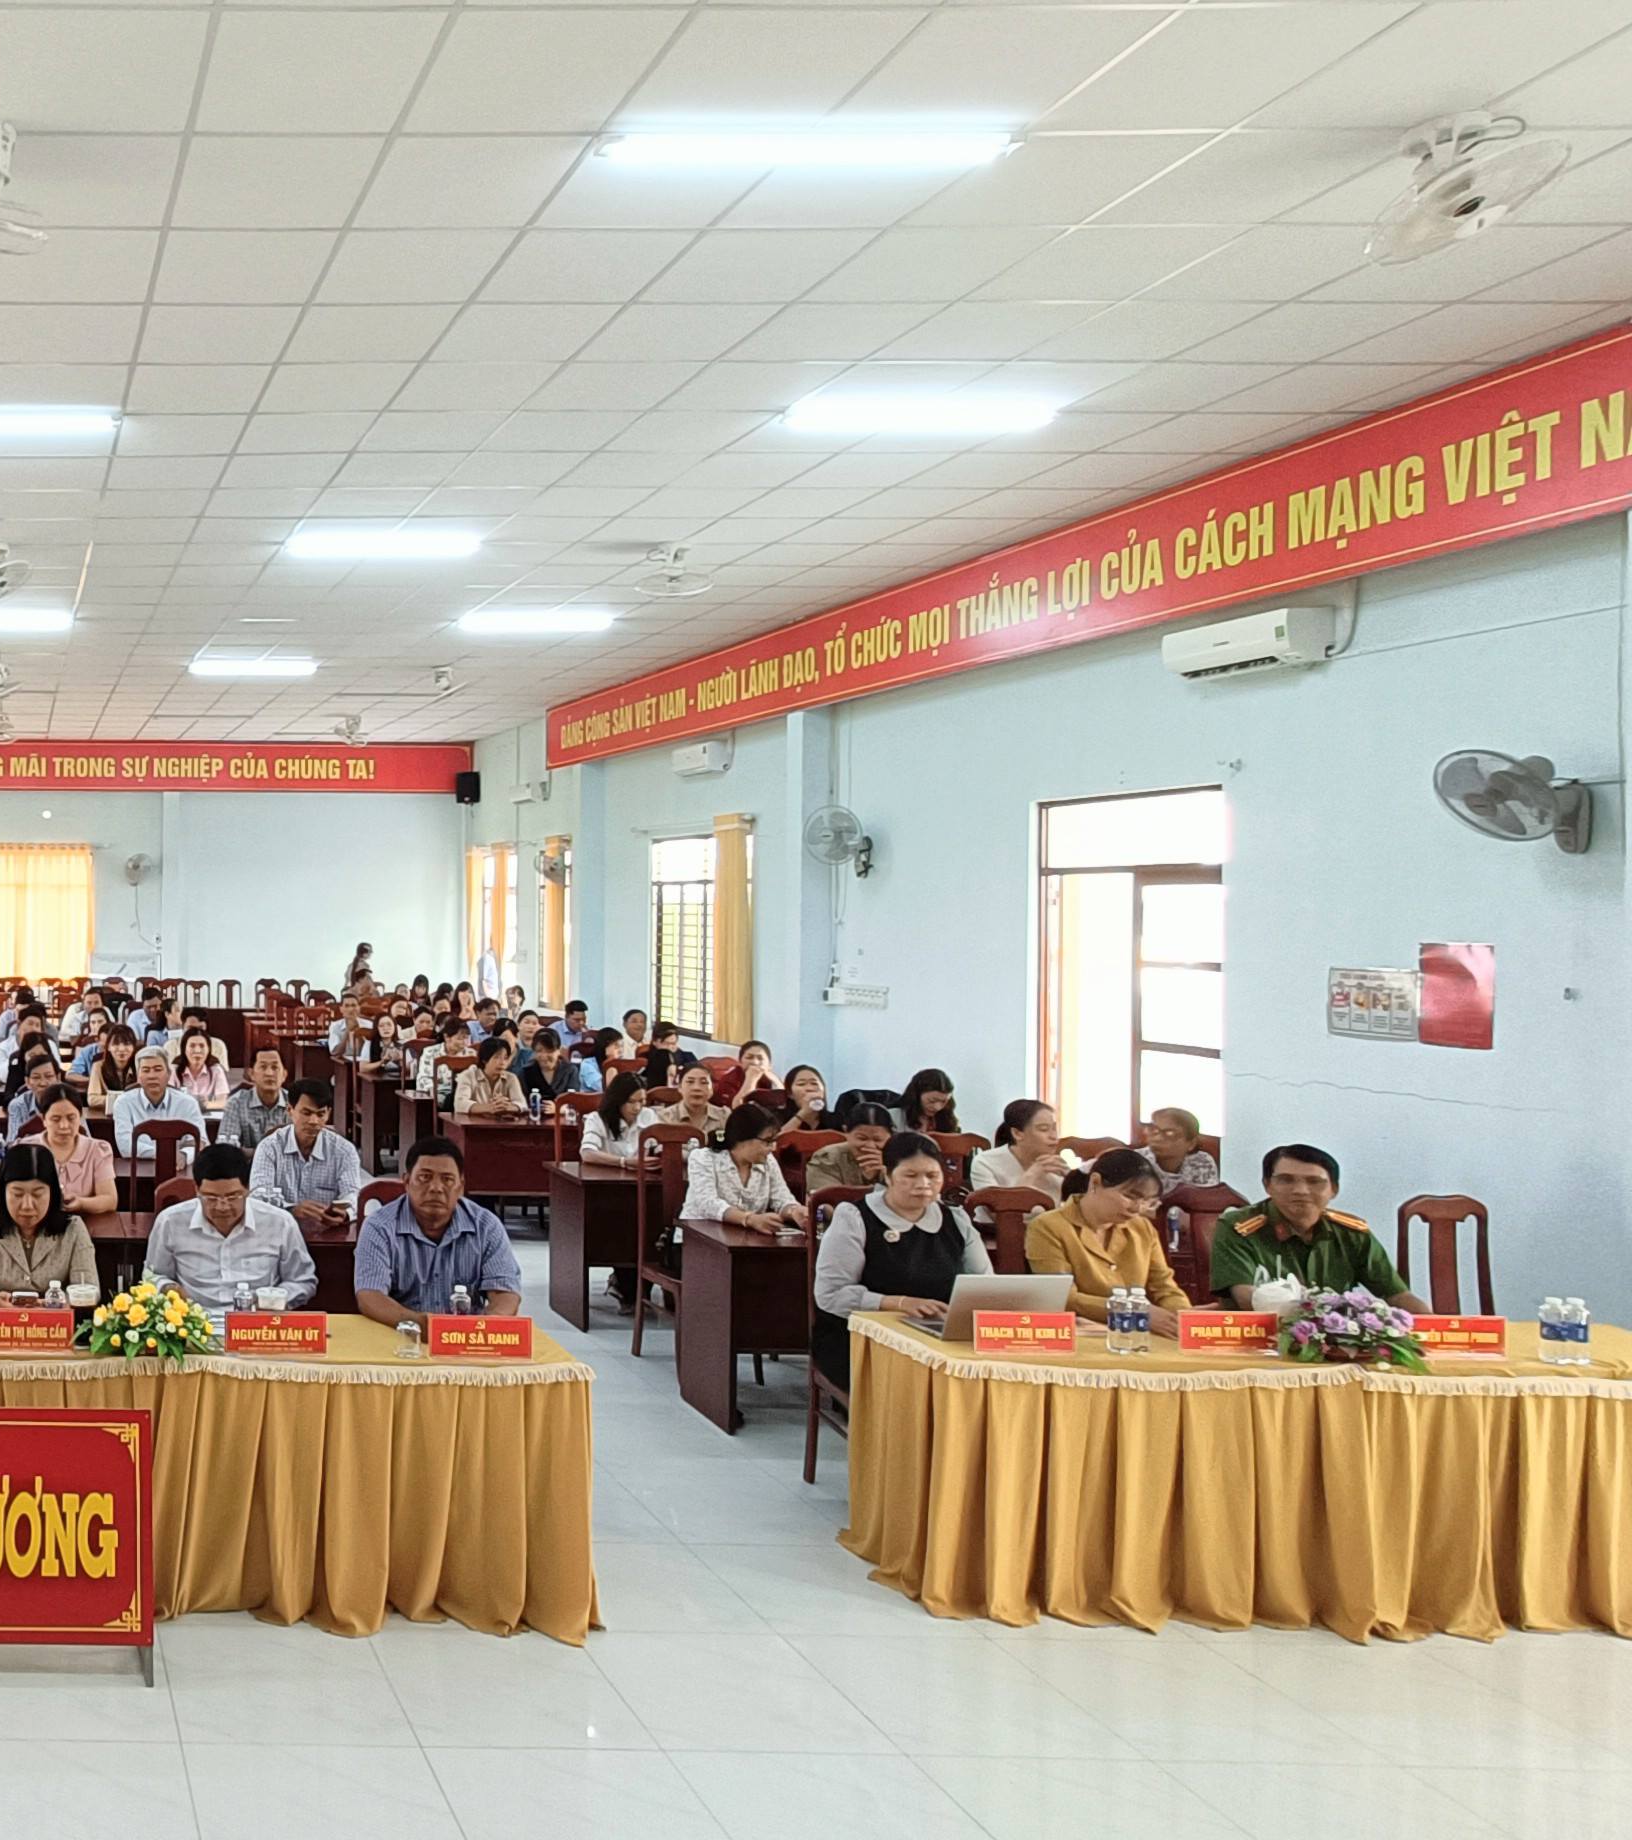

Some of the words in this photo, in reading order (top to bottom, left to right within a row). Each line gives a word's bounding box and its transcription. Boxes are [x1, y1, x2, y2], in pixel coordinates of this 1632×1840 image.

[585, 710, 611, 747] CỘNG
[612, 698, 633, 736] SẢN
[634, 693, 658, 733] VIỆT
[659, 687, 687, 723] NAM
[697, 665, 738, 713] NGƯỜI
[740, 658, 779, 700] LÃNH
[782, 647, 820, 693] ĐẠO,
[824, 622, 848, 675] TỔ
[850, 617, 903, 670] CHỨC
[908, 604, 950, 656] MỌI
[956, 572, 1039, 640] THẮNG
[1047, 557, 1091, 620] LỢI
[1100, 528, 1164, 600] CỦA
[1174, 507, 1275, 581] CÁCH
[1288, 455, 1426, 550] MẠNG
[1441, 409, 1561, 507] VIỆT
[9, 754, 48, 778] MÃI
[53, 756, 116, 779] TRONG
[121, 755, 149, 783] SỰ
[153, 753, 224, 783] NGHIỆP
[229, 751, 269, 780] CỦA
[274, 754, 342, 780] CHÚNG
[346, 758, 376, 781] TA!
[231, 1325, 277, 1341] NGUYỄN
[279, 1327, 303, 1341] VĂN
[441, 1331, 466, 1344] SƠN
[487, 1333, 520, 1345] RANH
